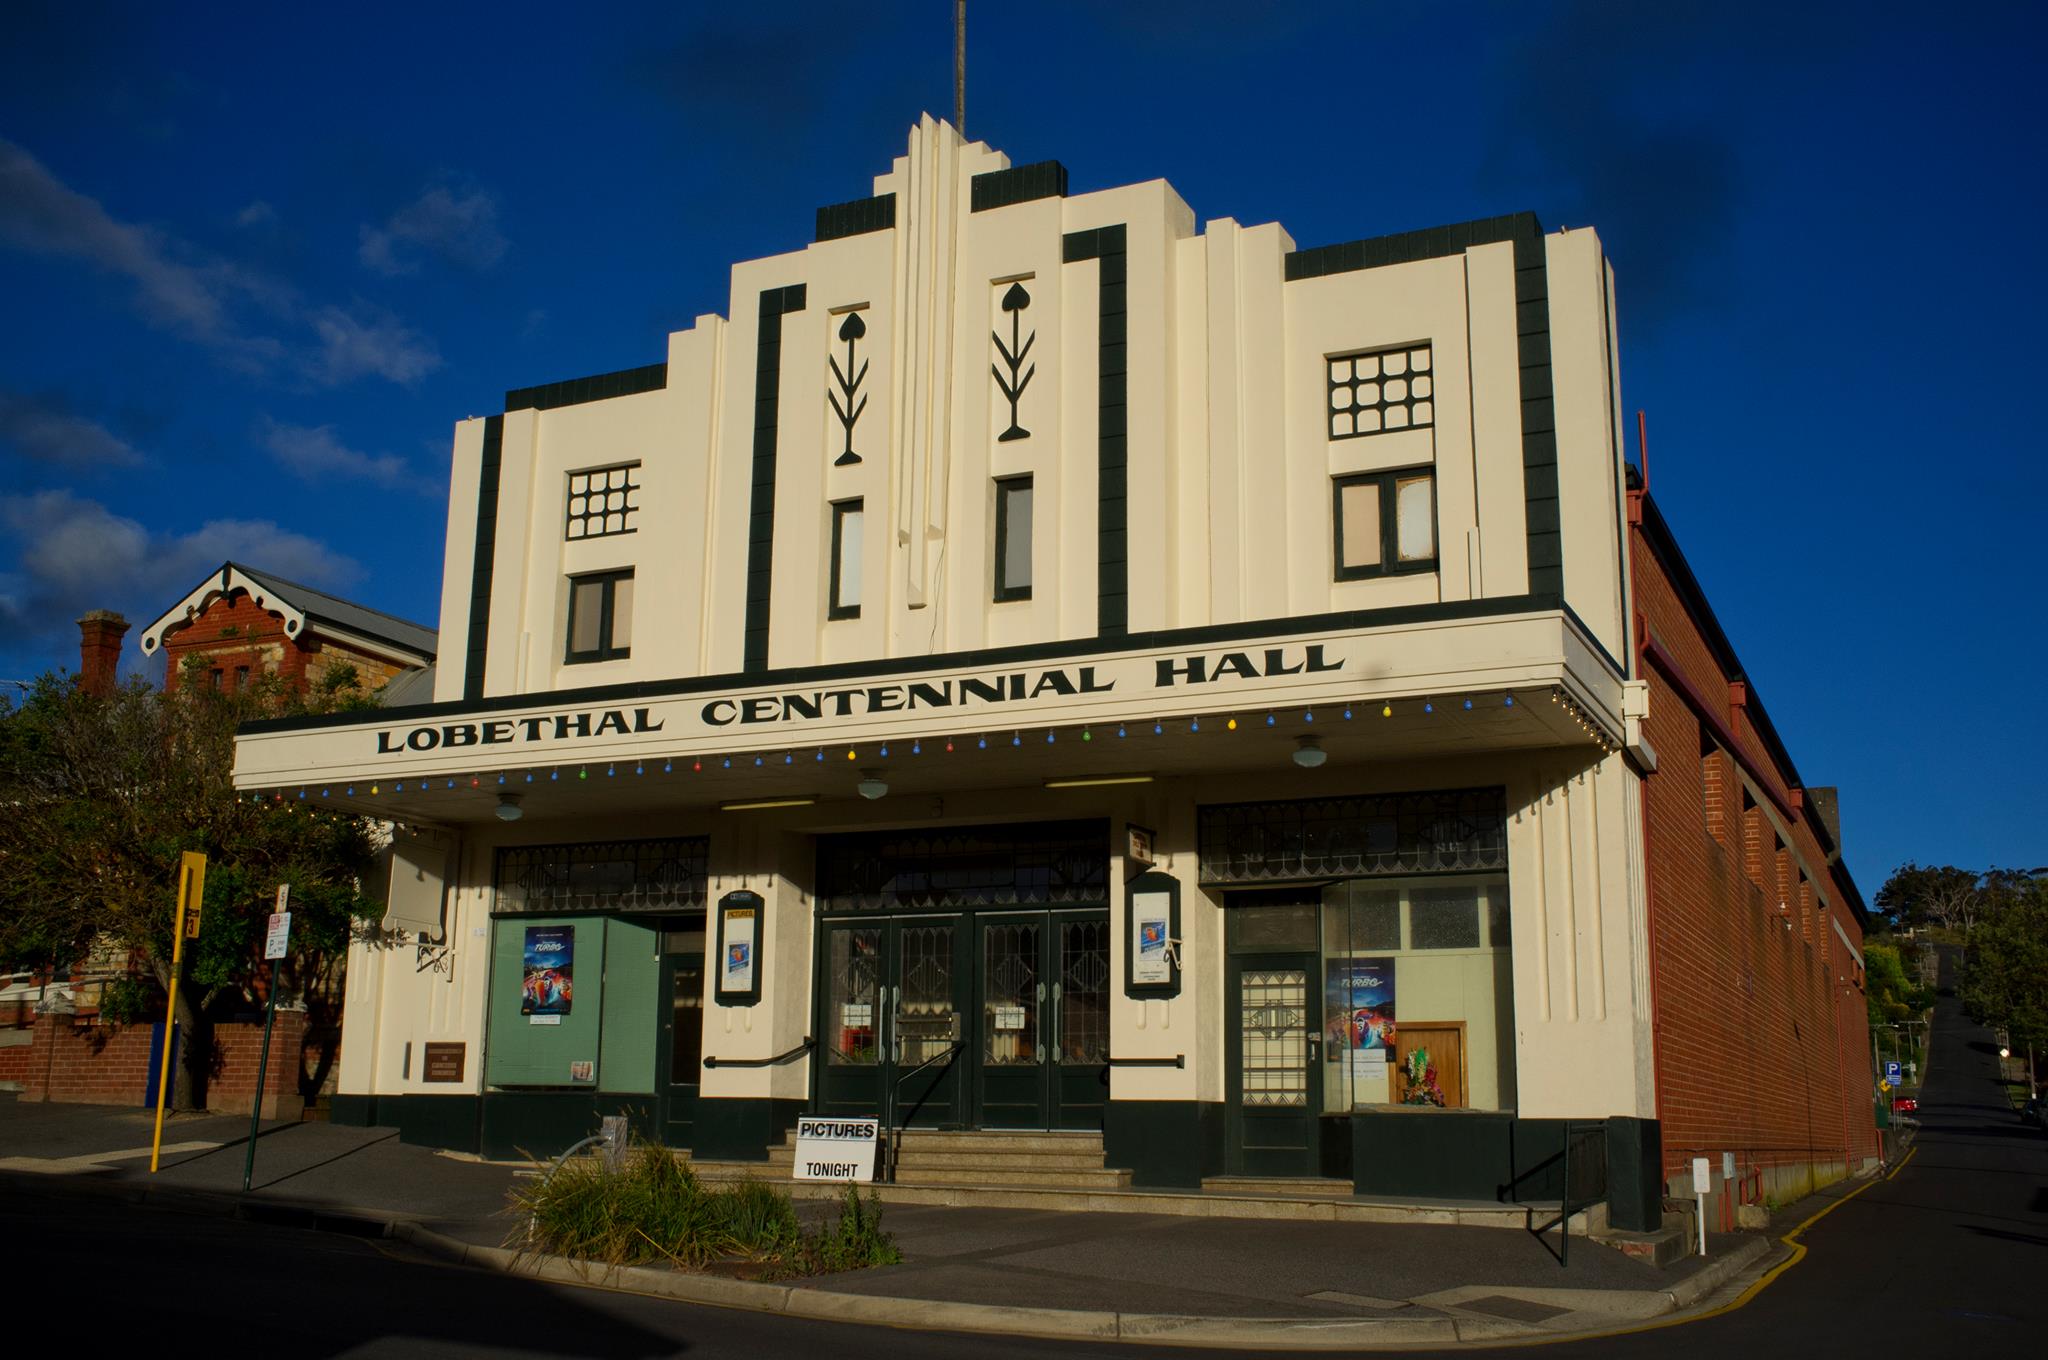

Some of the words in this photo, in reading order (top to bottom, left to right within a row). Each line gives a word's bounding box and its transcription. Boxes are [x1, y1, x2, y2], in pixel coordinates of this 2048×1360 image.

[377, 708, 665, 754] LOBETHAL
[701, 666, 1117, 726] CENTENNIAL
[1155, 644, 1345, 688] HALL
[534, 943, 565, 952] TURBO
[1341, 978, 1385, 987] TURBO
[1888, 1063, 1898, 1074] P
[801, 1123, 875, 1138] PICTURES
[806, 1162, 859, 1178] TONIGHT
